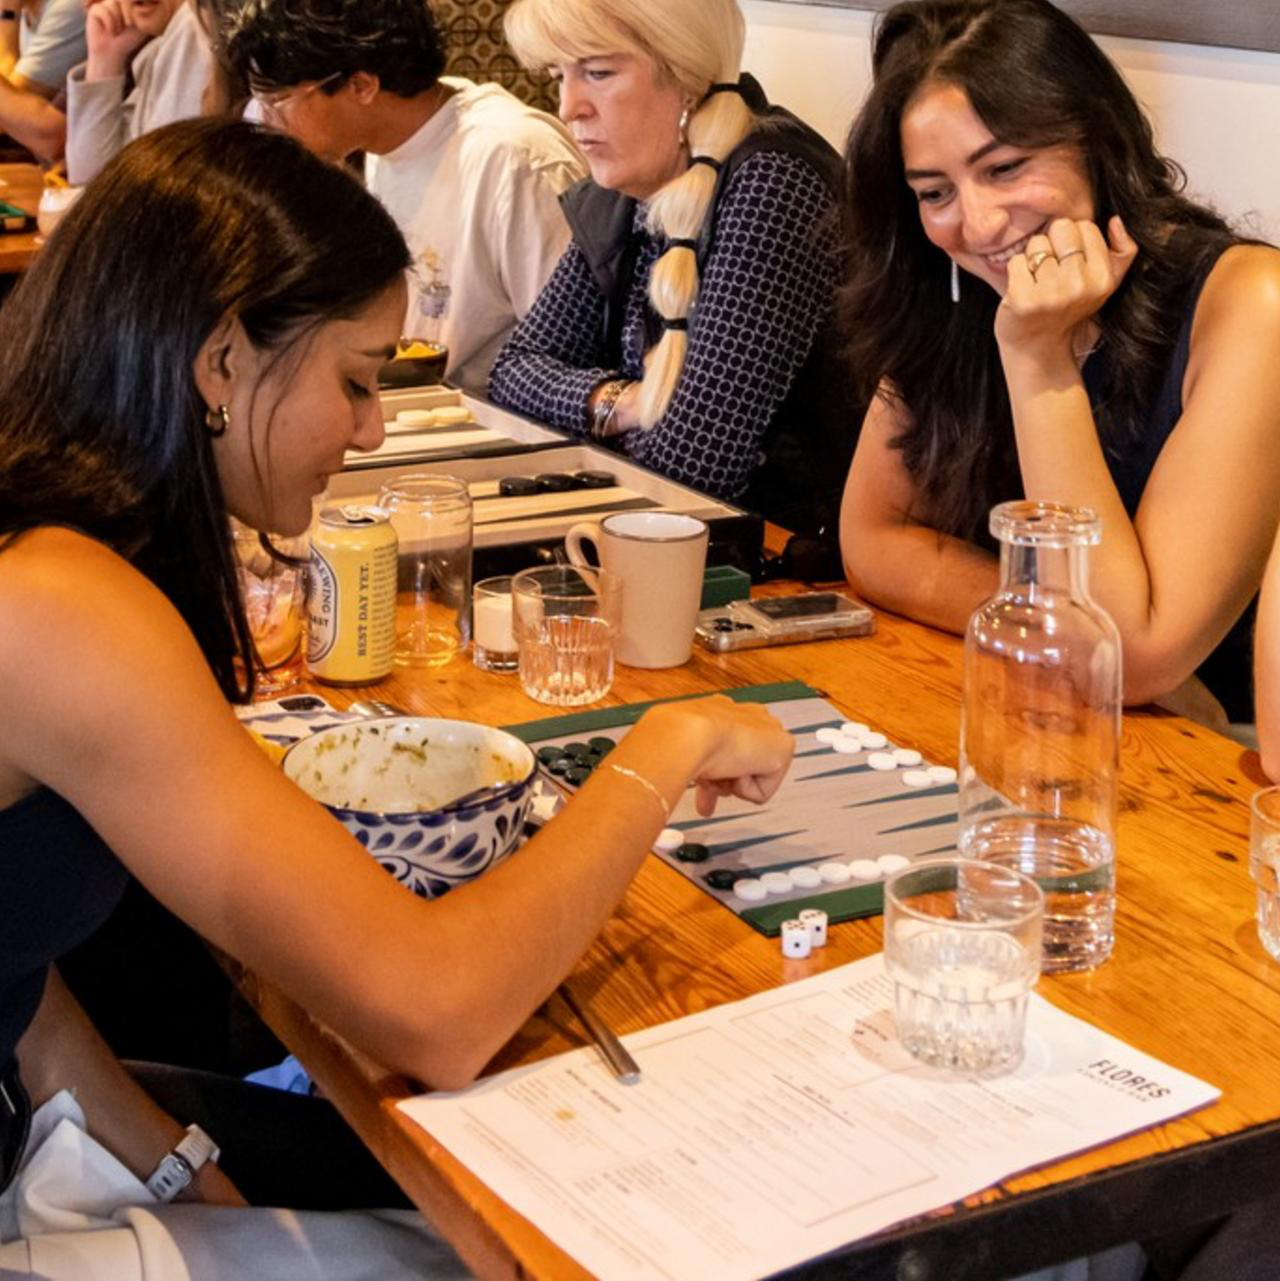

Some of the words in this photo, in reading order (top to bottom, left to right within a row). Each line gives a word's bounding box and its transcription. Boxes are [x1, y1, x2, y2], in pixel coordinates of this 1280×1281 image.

[359, 562, 370, 593] YET.
[358, 594, 369, 621] DAY
[357, 625, 368, 657] BEST
[1087, 1059, 1171, 1098] FLORES
